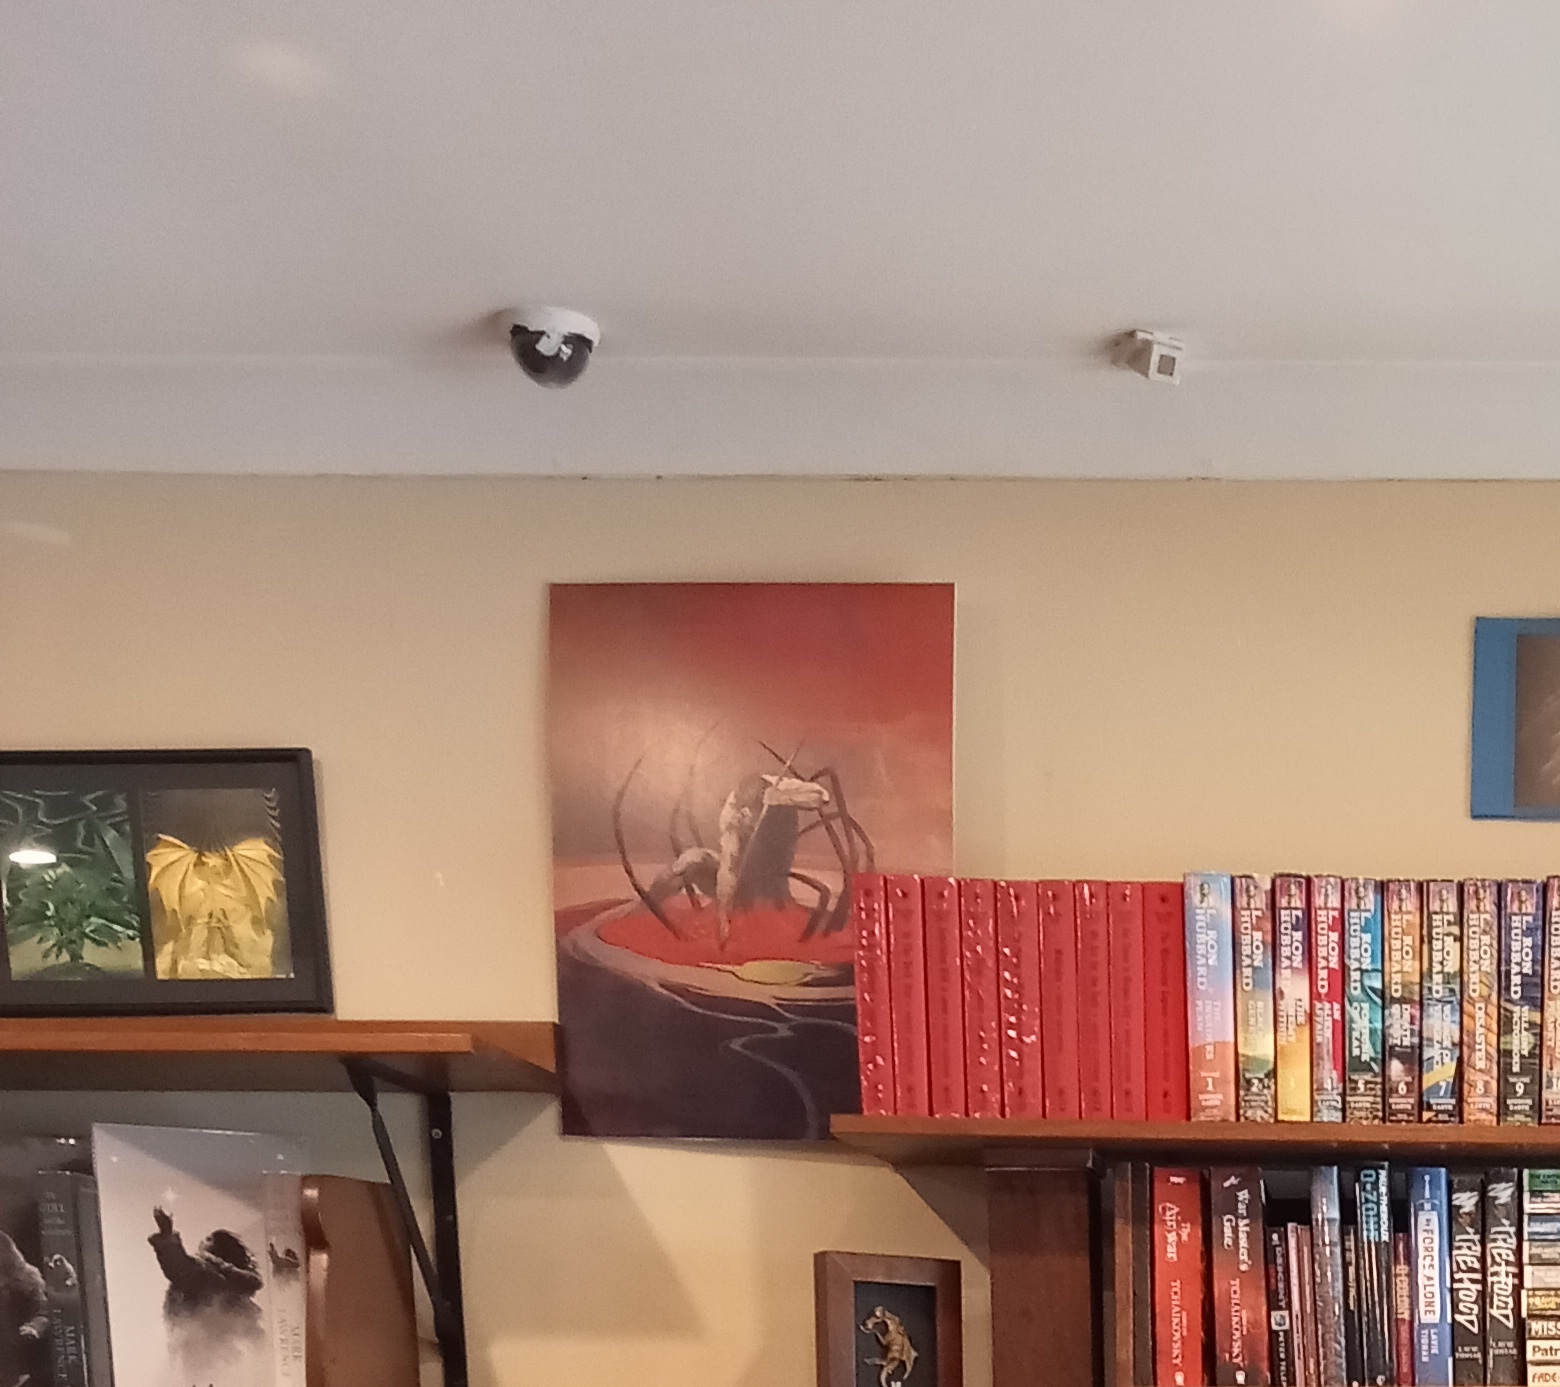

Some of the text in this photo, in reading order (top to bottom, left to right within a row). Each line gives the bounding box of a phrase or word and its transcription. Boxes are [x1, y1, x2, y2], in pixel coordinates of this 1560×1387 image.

[1317, 910, 1328, 993] HUBBARD
[1328, 930, 1339, 969] RON
[1510, 915, 1522, 999] HUBBARD
[1522, 939, 1533, 975] RON
[1236, 1189, 1249, 1215] War
[1422, 1228, 1436, 1317] FORCE ALONE
